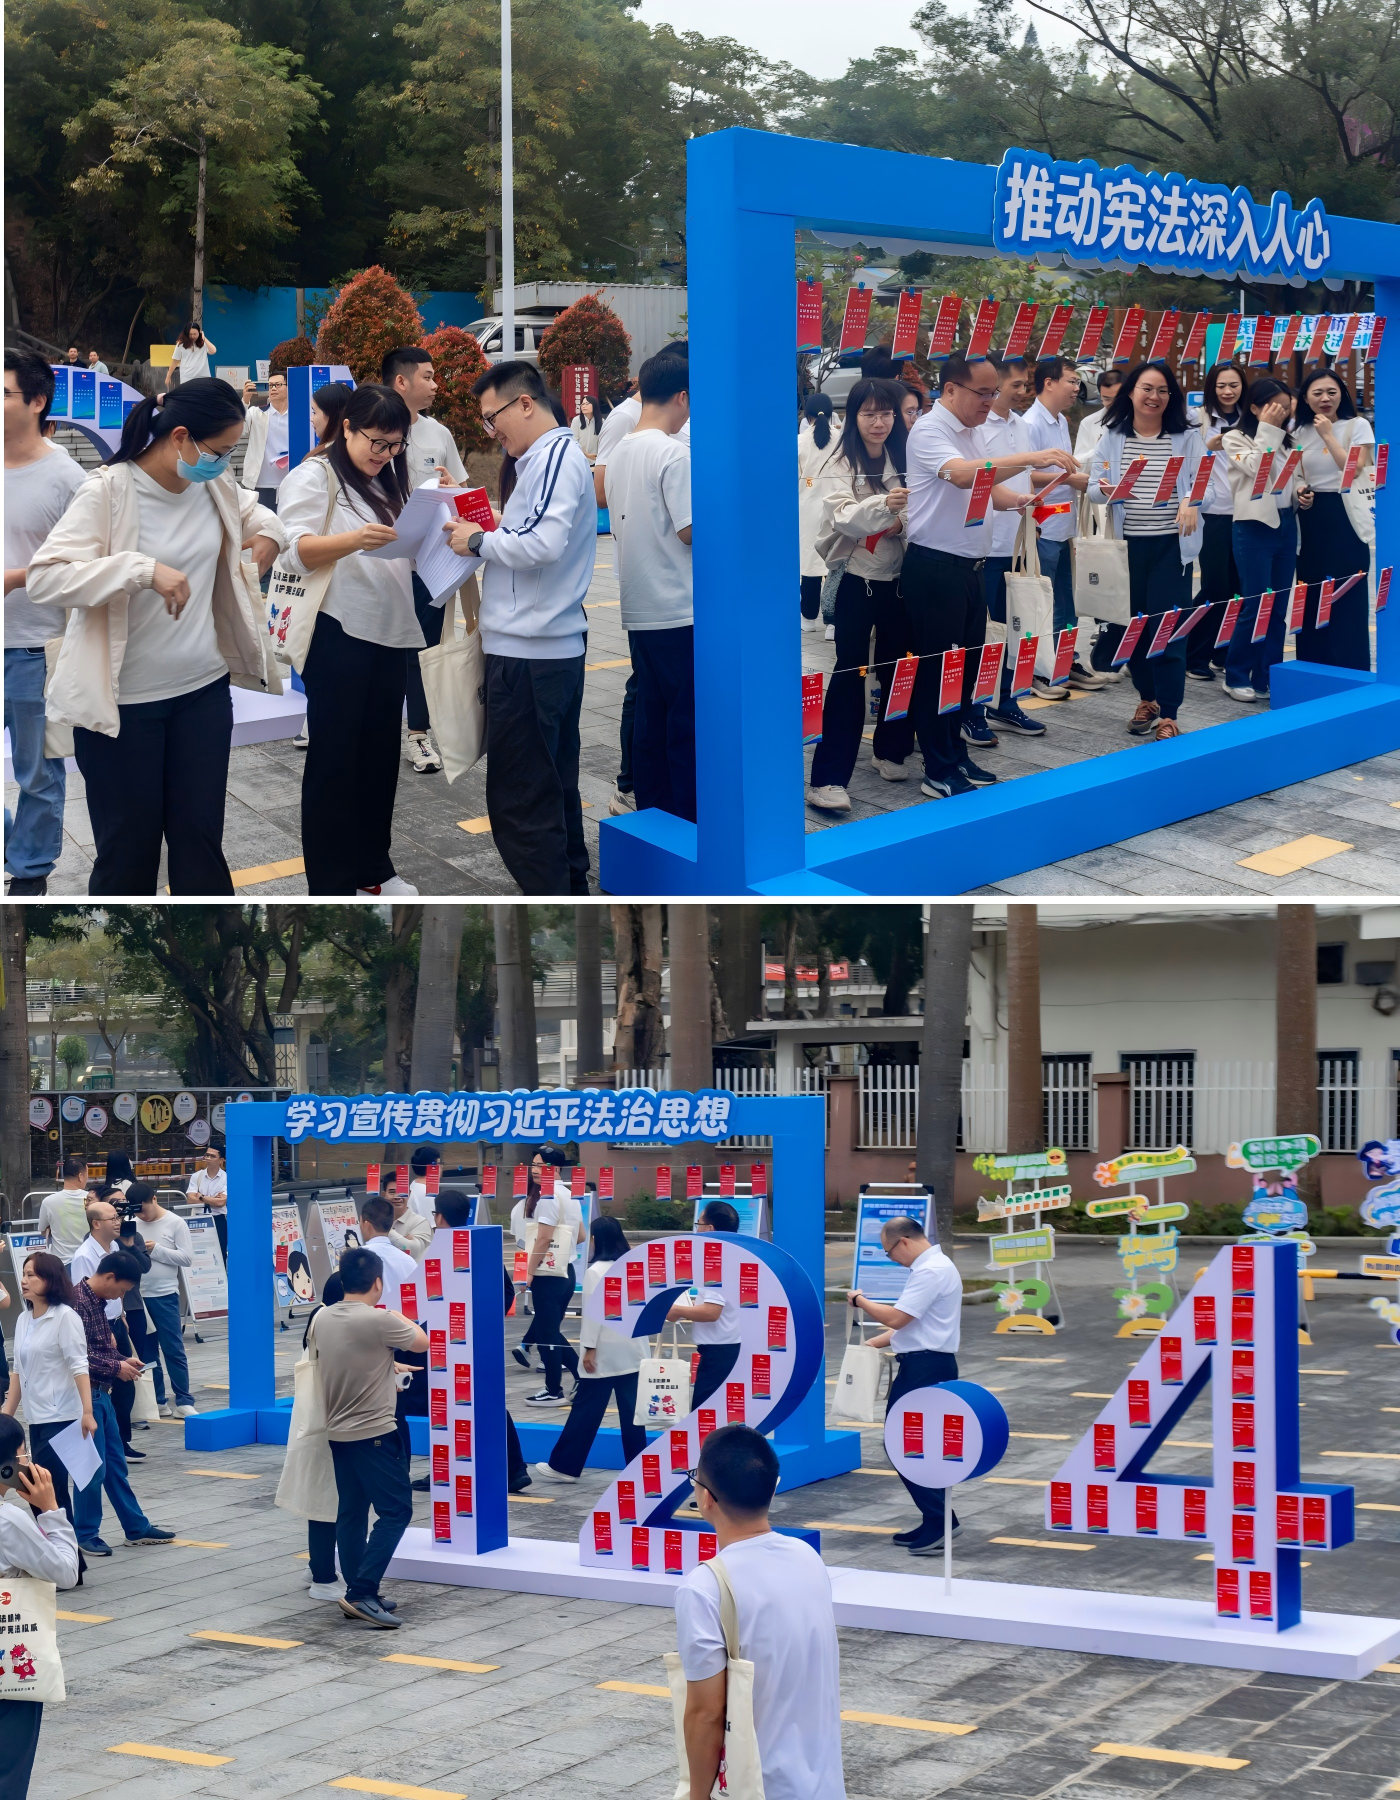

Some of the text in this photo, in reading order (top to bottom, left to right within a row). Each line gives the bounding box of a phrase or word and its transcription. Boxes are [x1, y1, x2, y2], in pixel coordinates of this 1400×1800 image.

[1003, 161, 1331, 270] 推动宪法深入人心
[285, 1096, 731, 1139] 学习宣传贯彻习近平法治思想
